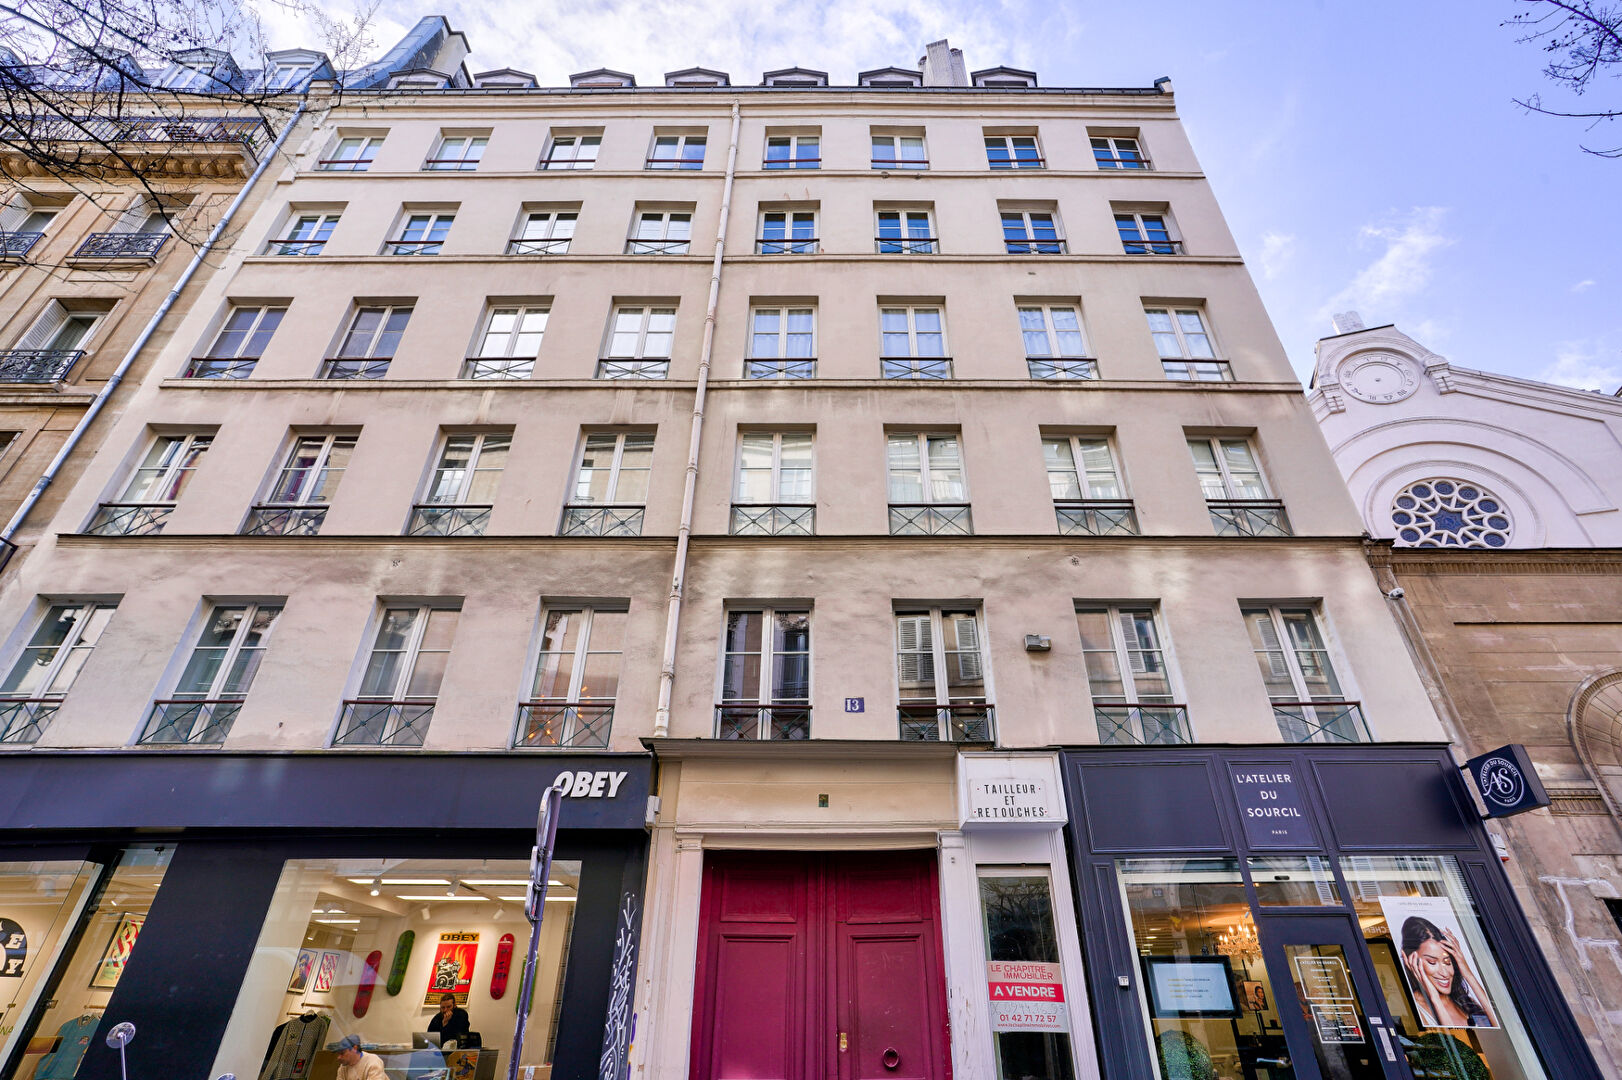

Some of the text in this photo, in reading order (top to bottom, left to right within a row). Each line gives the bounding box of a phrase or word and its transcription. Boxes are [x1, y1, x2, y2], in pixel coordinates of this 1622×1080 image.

[846, 699, 860, 711] 13
[552, 770, 628, 798] OBEY
[1236, 774, 1292, 784] L'ATELIER
[984, 784, 1036, 794] TAILLEUR
[1260, 790, 1277, 800] DU
[1004, 795, 1015, 806] ET
[977, 807, 1044, 818] RETOUCHES
[1247, 807, 1301, 817] SOURCIL
[440, 933, 479, 942] OBEY
[990, 964, 1046, 974] LE CHAPITRE
[1003, 972, 1055, 980] IMMOBILIER
[994, 985, 1056, 998] A VENDRE
[999, 1014, 1057, 1023] 01 42 71 72 57
